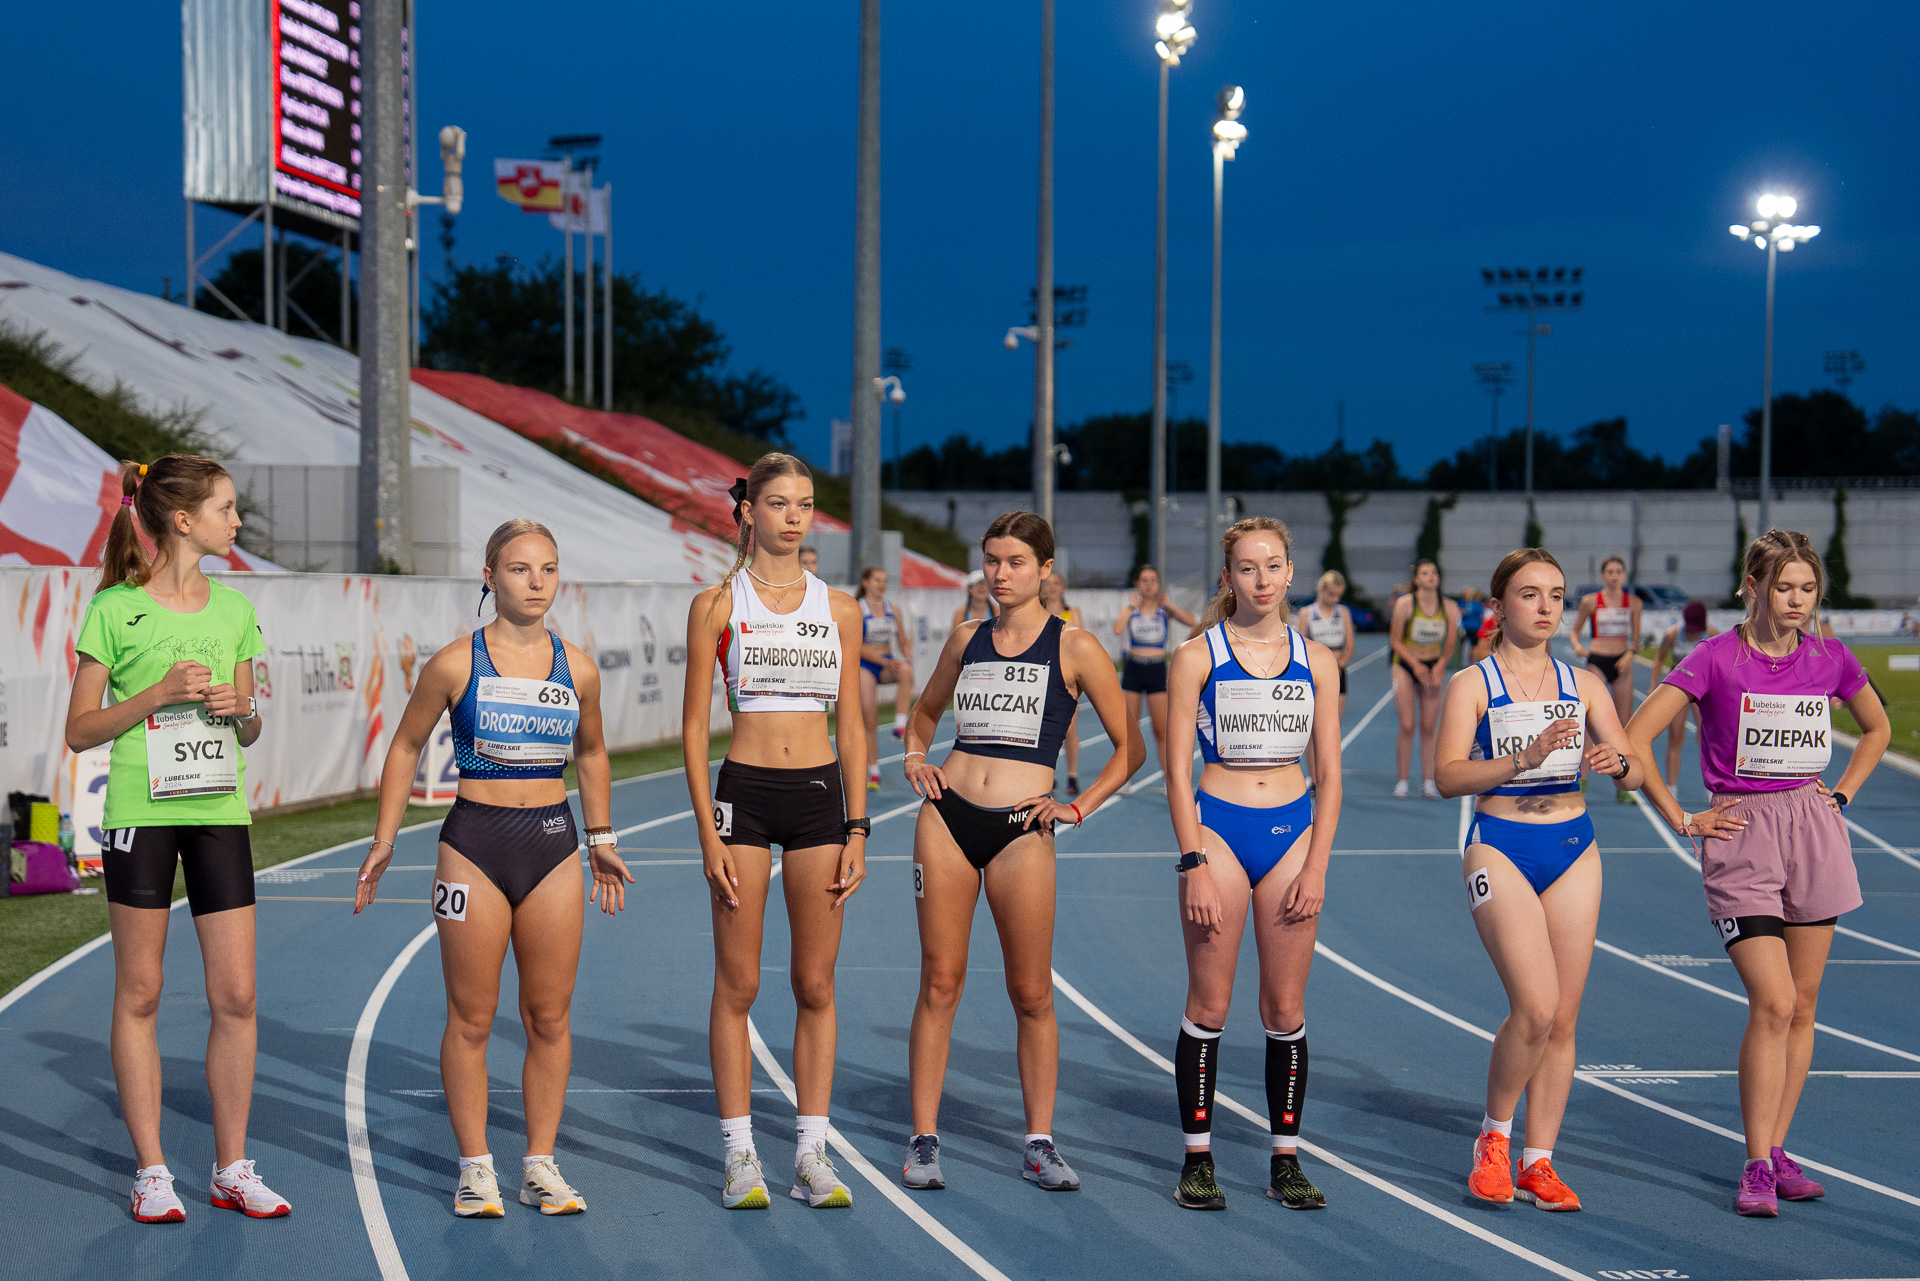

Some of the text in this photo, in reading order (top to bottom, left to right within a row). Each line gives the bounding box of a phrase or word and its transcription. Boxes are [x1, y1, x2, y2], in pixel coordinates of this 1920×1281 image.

[797, 621, 829, 638] 397
[744, 646, 837, 669] ZEMBROWSKA
[1004, 666, 1038, 683] 815
[538, 687, 570, 706] 639
[1272, 684, 1305, 700] 622
[957, 692, 1040, 715] WALCZAK
[1544, 704, 1578, 720] 502
[1753, 700, 1786, 709] lubelskie
[1795, 701, 1824, 716] 469
[156, 711, 194, 723] lubelskie
[479, 710, 574, 738] DROZDOWSKA
[1219, 710, 1310, 733] WAWRZYŃCZAK
[488, 743, 521, 752] LUBELSKIE
[1496, 731, 1582, 756] KRAEC
[1745, 728, 1826, 748] DZIEPAK
[174, 740, 224, 762] SYCZ
[164, 773, 202, 782] LUBELSKIE
[542, 816, 565, 828] MKS
[1008, 810, 1036, 824] NIK
[914, 868, 922, 892] 8
[1468, 874, 1490, 904] 16
[434, 884, 466, 916] 20
[1198, 1043, 1208, 1106] COMPRESSPORT
[1286, 1044, 1298, 1110] COMPRESSPORT
[1597, 1269, 1690, 1280] 200
